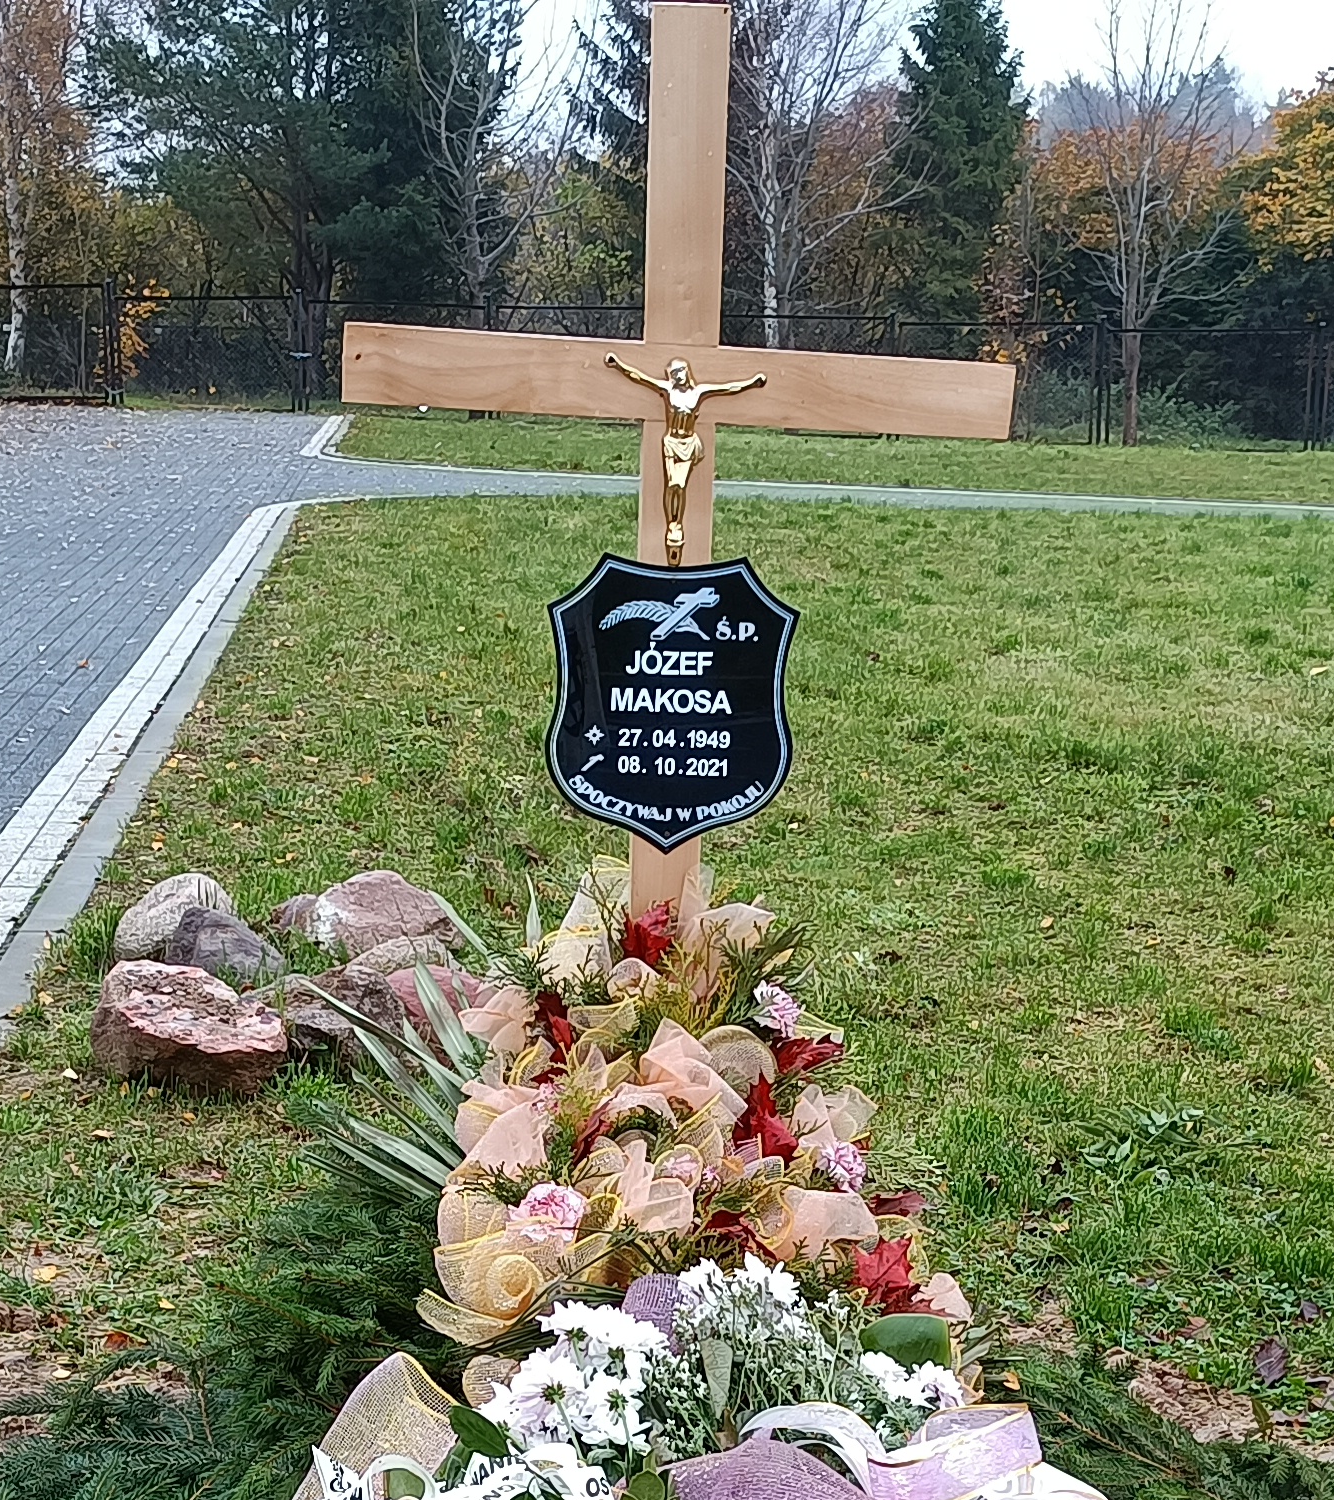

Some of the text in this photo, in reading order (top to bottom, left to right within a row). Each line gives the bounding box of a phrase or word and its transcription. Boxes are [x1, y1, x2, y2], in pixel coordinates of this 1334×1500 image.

[715, 615, 759, 642] Ś.P.
[625, 641, 714, 676] JÓZEF
[610, 687, 732, 714] MAKOSA
[568, 774, 765, 822] SPOCZYWAJ W POKOJU
